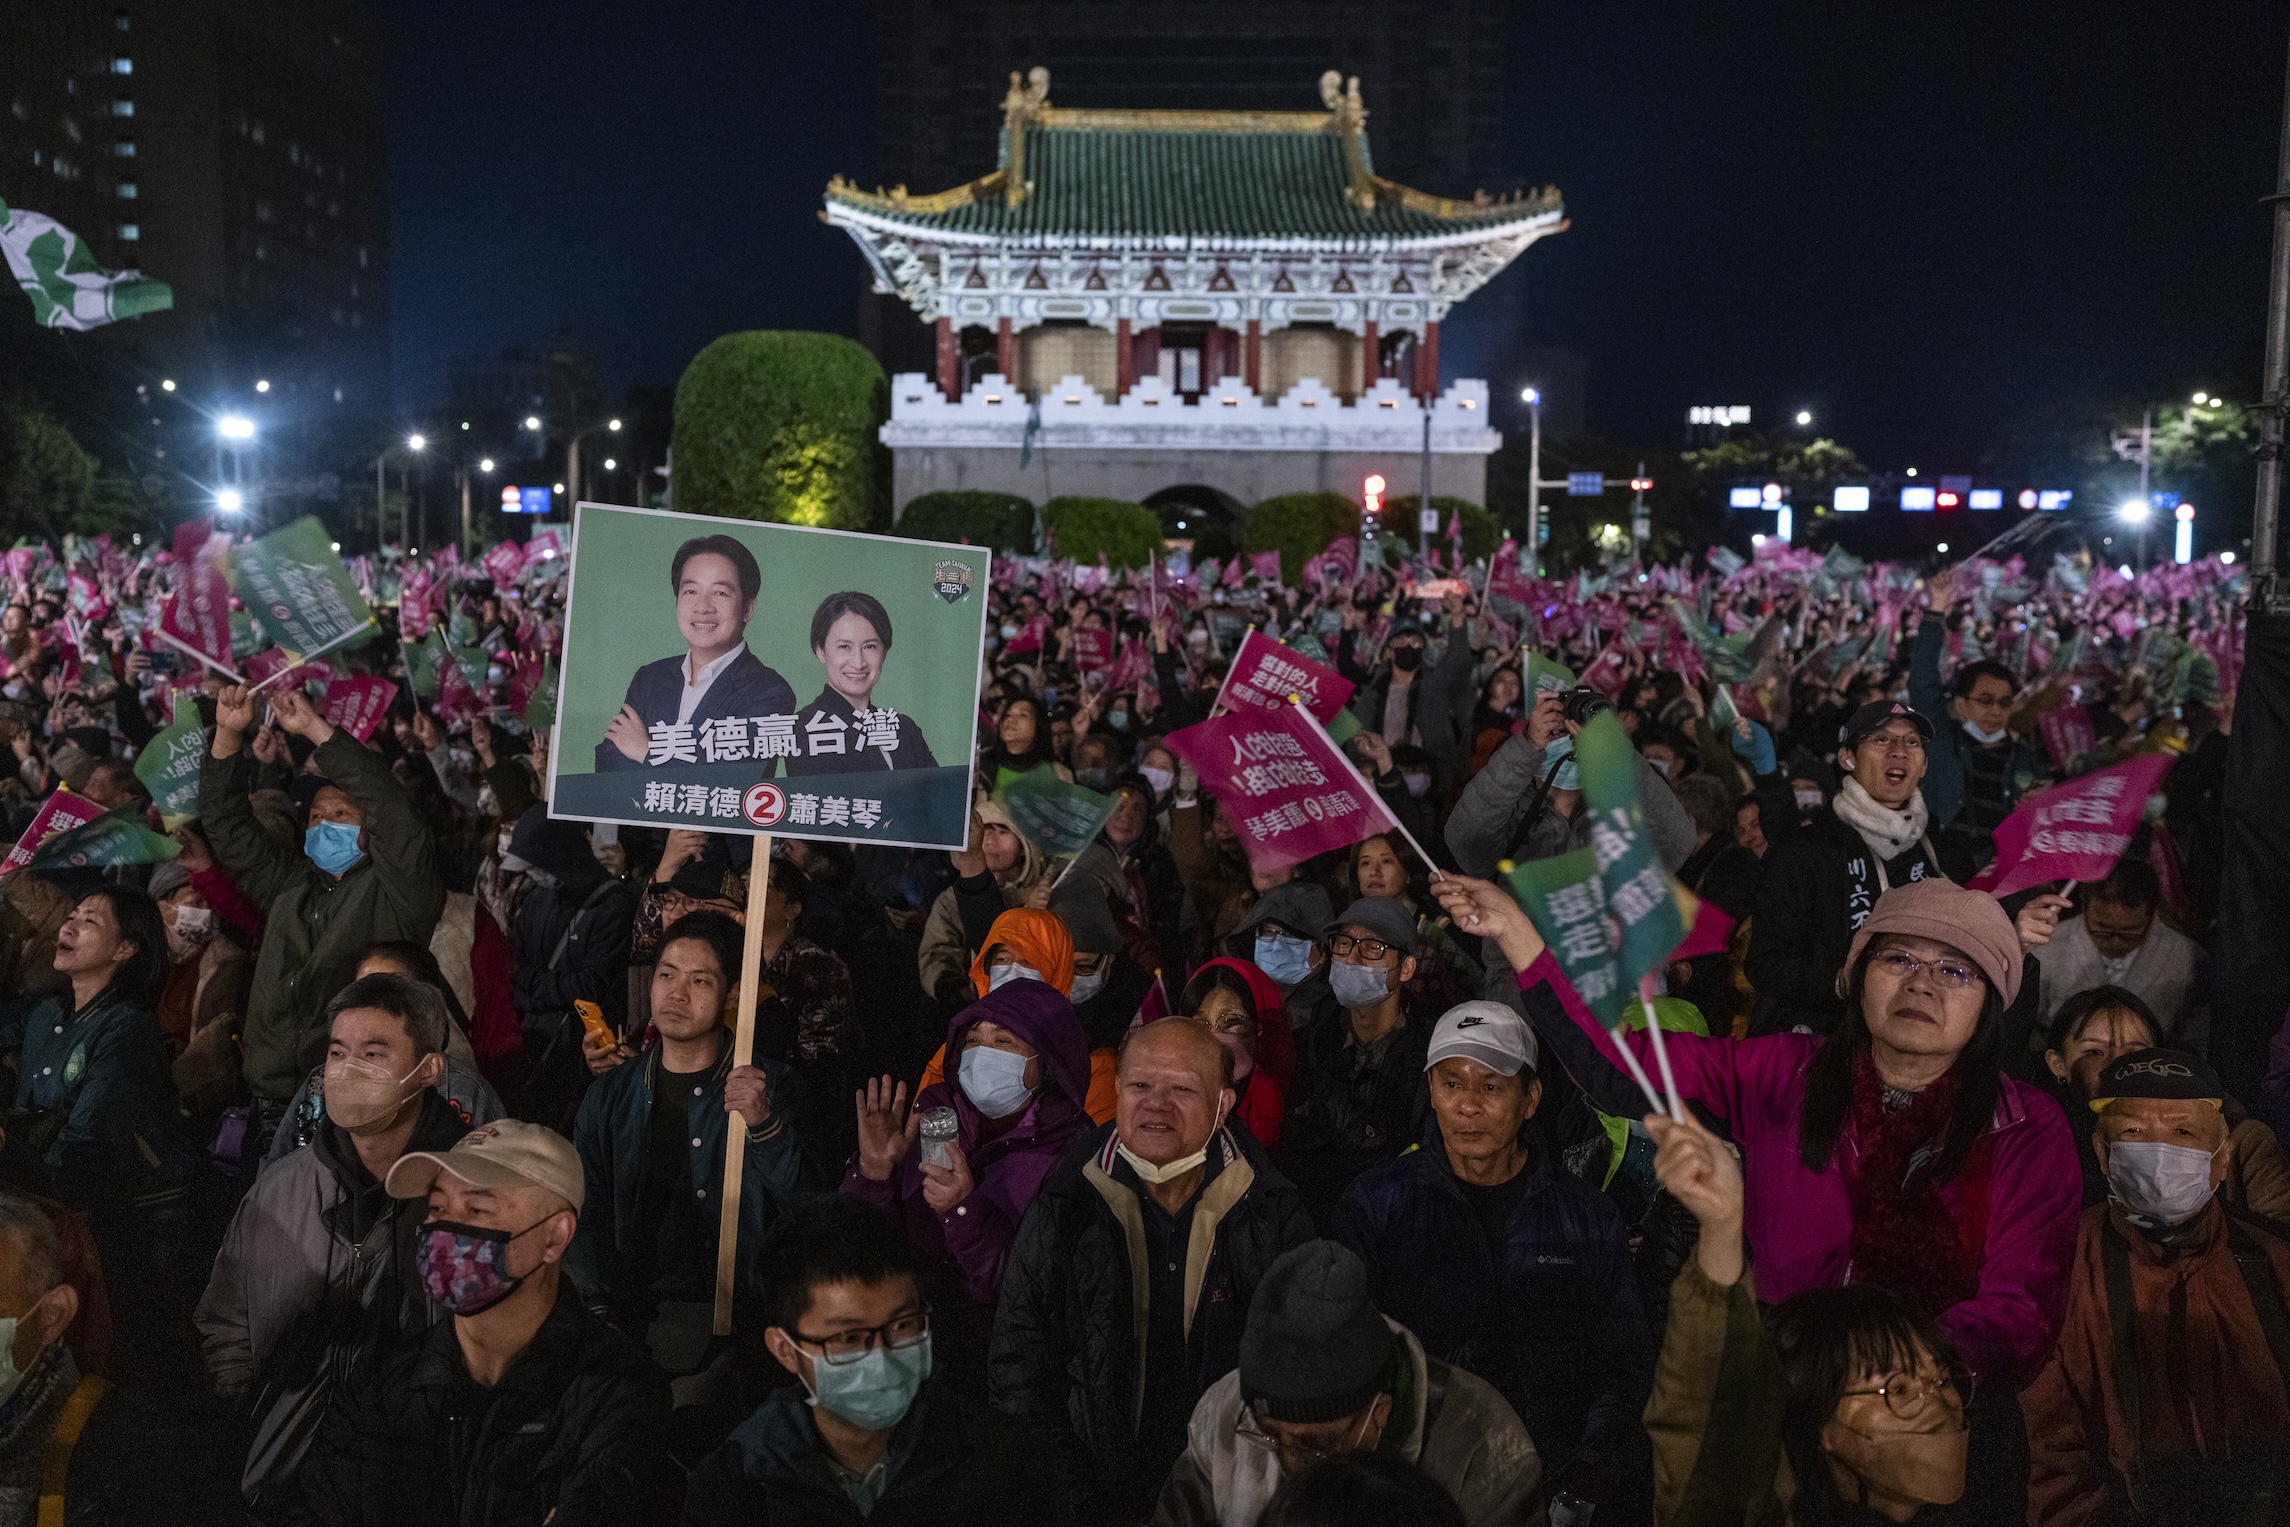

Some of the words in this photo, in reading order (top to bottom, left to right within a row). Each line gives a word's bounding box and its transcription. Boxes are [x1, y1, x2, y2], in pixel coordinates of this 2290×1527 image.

[935, 560, 950, 569] TEAM
[951, 560, 972, 572] TAIWAN
[941, 583, 962, 594] 2024
[648, 707, 900, 766] 美德贏台灣
[644, 781, 742, 818] 賴清德
[749, 787, 780, 822] 2
[787, 793, 883, 830] 蕭美琴
[1463, 1016, 1484, 1024] NIKE
[2114, 1059, 2193, 1080] WEGO
